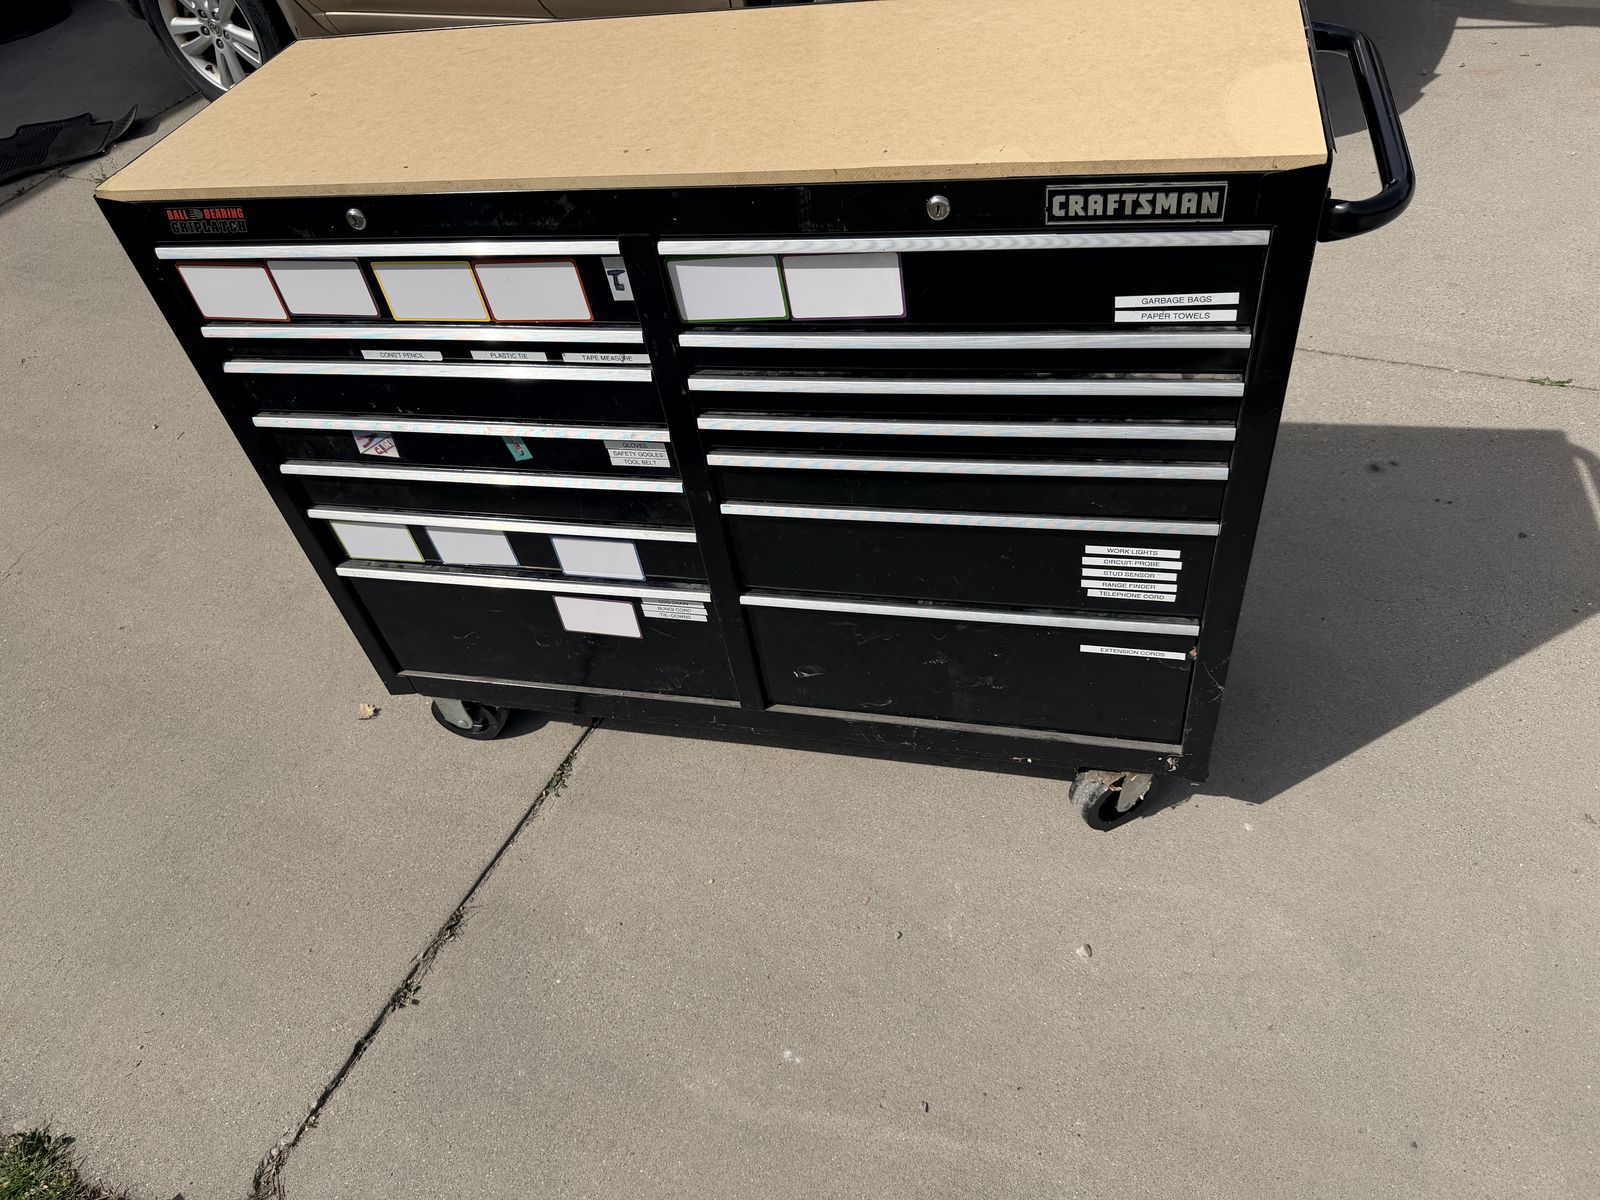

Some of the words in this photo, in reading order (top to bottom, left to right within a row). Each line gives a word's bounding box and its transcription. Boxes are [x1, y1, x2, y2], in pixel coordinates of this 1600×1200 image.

[1052, 192, 1219, 217] CRAFTSMAN
[166, 209, 189, 220] BALL
[203, 207, 244, 219] BEARING
[170, 219, 248, 234] GRIPLATCH
[1141, 296, 1185, 305] GARBAGE
[1187, 295, 1212, 303] BAGS
[1141, 312, 1171, 320] PAPER
[1173, 312, 1211, 320] TOWELS
[1106, 547, 1130, 555] WORK
[1124, 571, 1156, 579] SENSOR
[1101, 581, 1128, 589] RANGE
[1099, 590, 1141, 599] TELEPHONE
[1100, 647, 1140, 656] EXTENSION
[1140, 650, 1166, 658] CORDS
